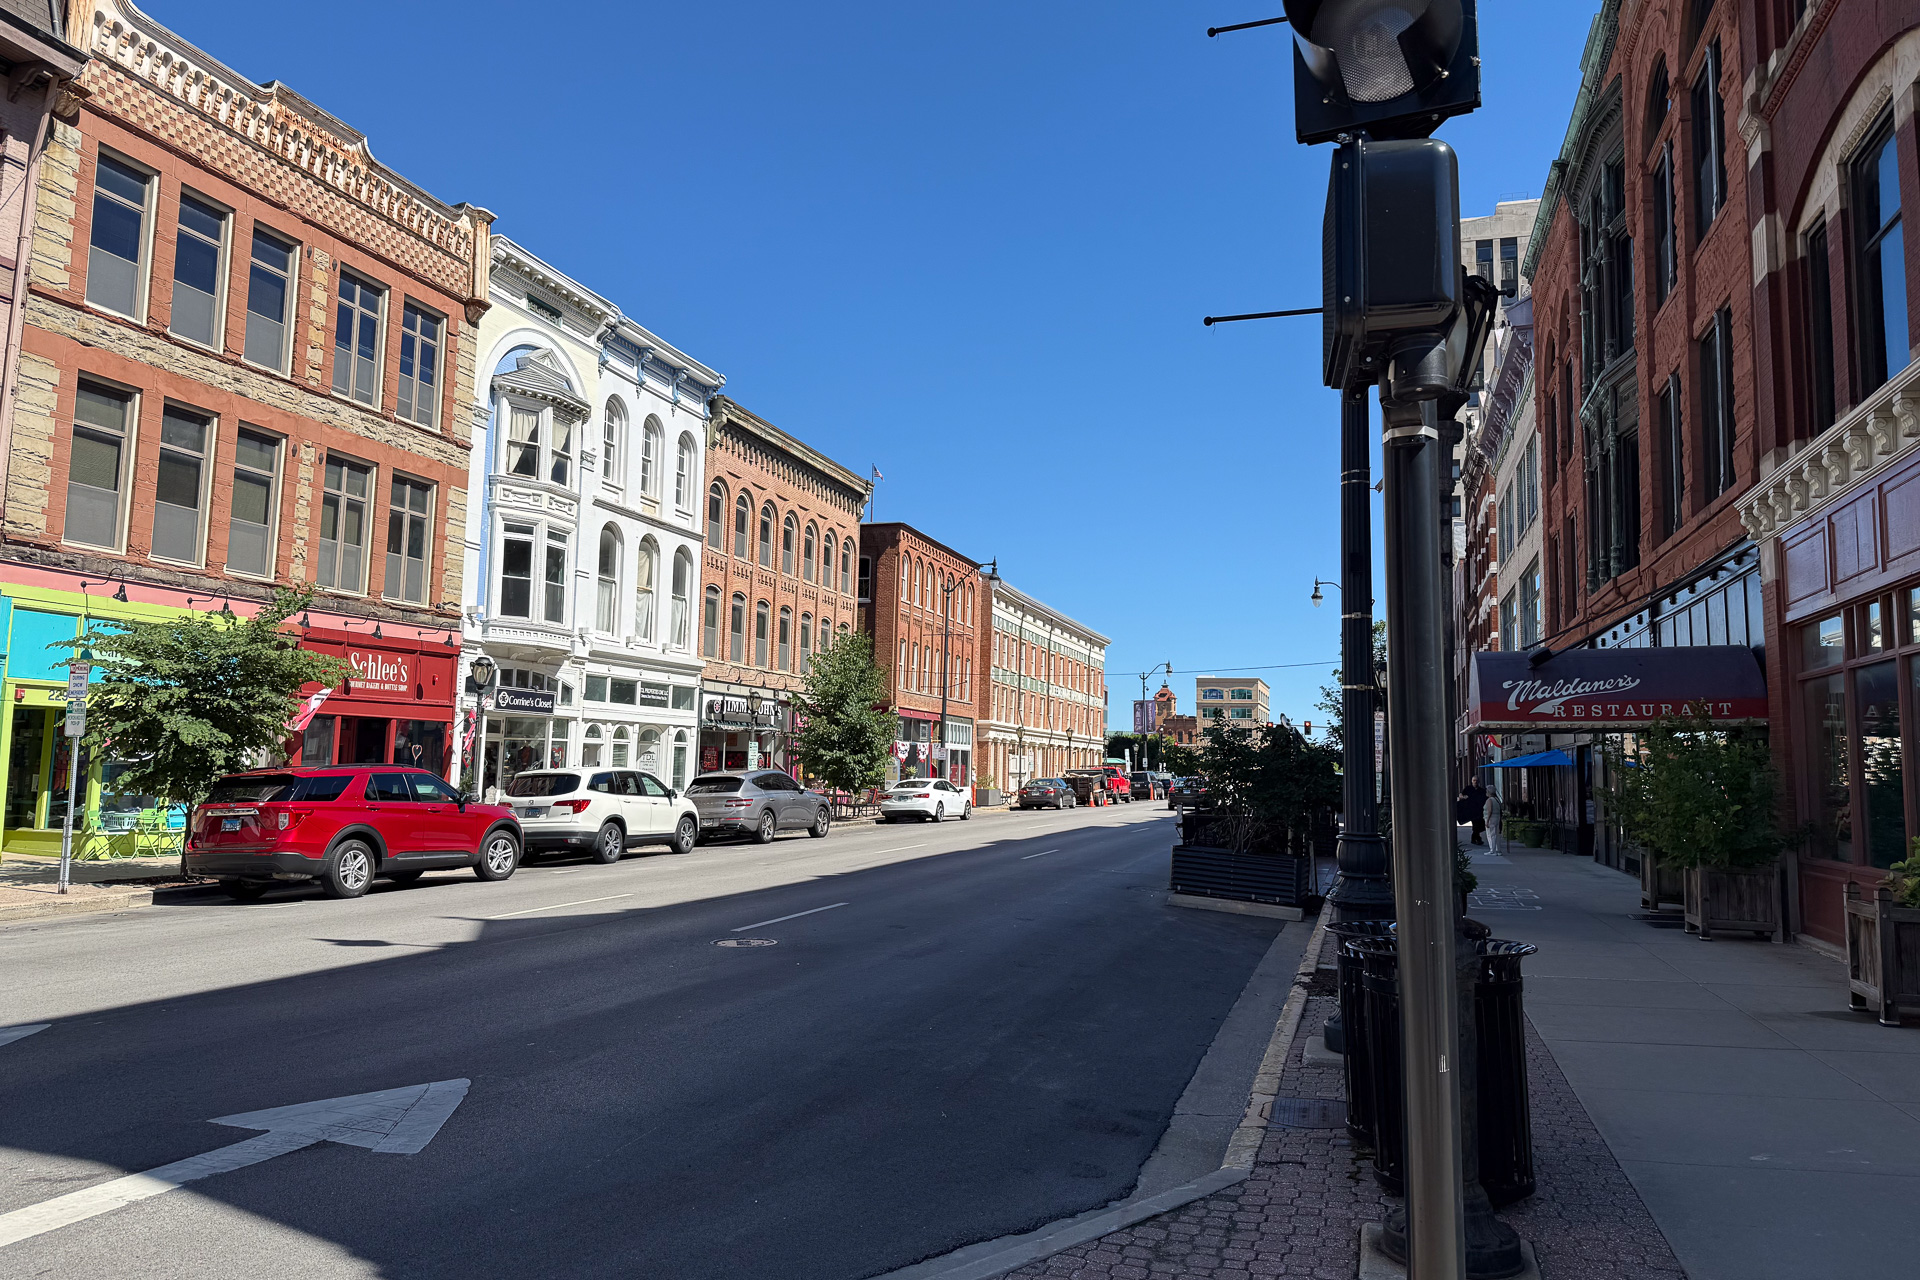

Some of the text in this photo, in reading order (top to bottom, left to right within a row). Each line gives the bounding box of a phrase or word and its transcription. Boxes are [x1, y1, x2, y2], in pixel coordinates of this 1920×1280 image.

[350, 652, 408, 682] Schlee's
[509, 695, 553, 709] Corrine's Closet
[1502, 673, 1641, 715] Maldaner's
[1552, 702, 1732, 718] RESTAURANT
